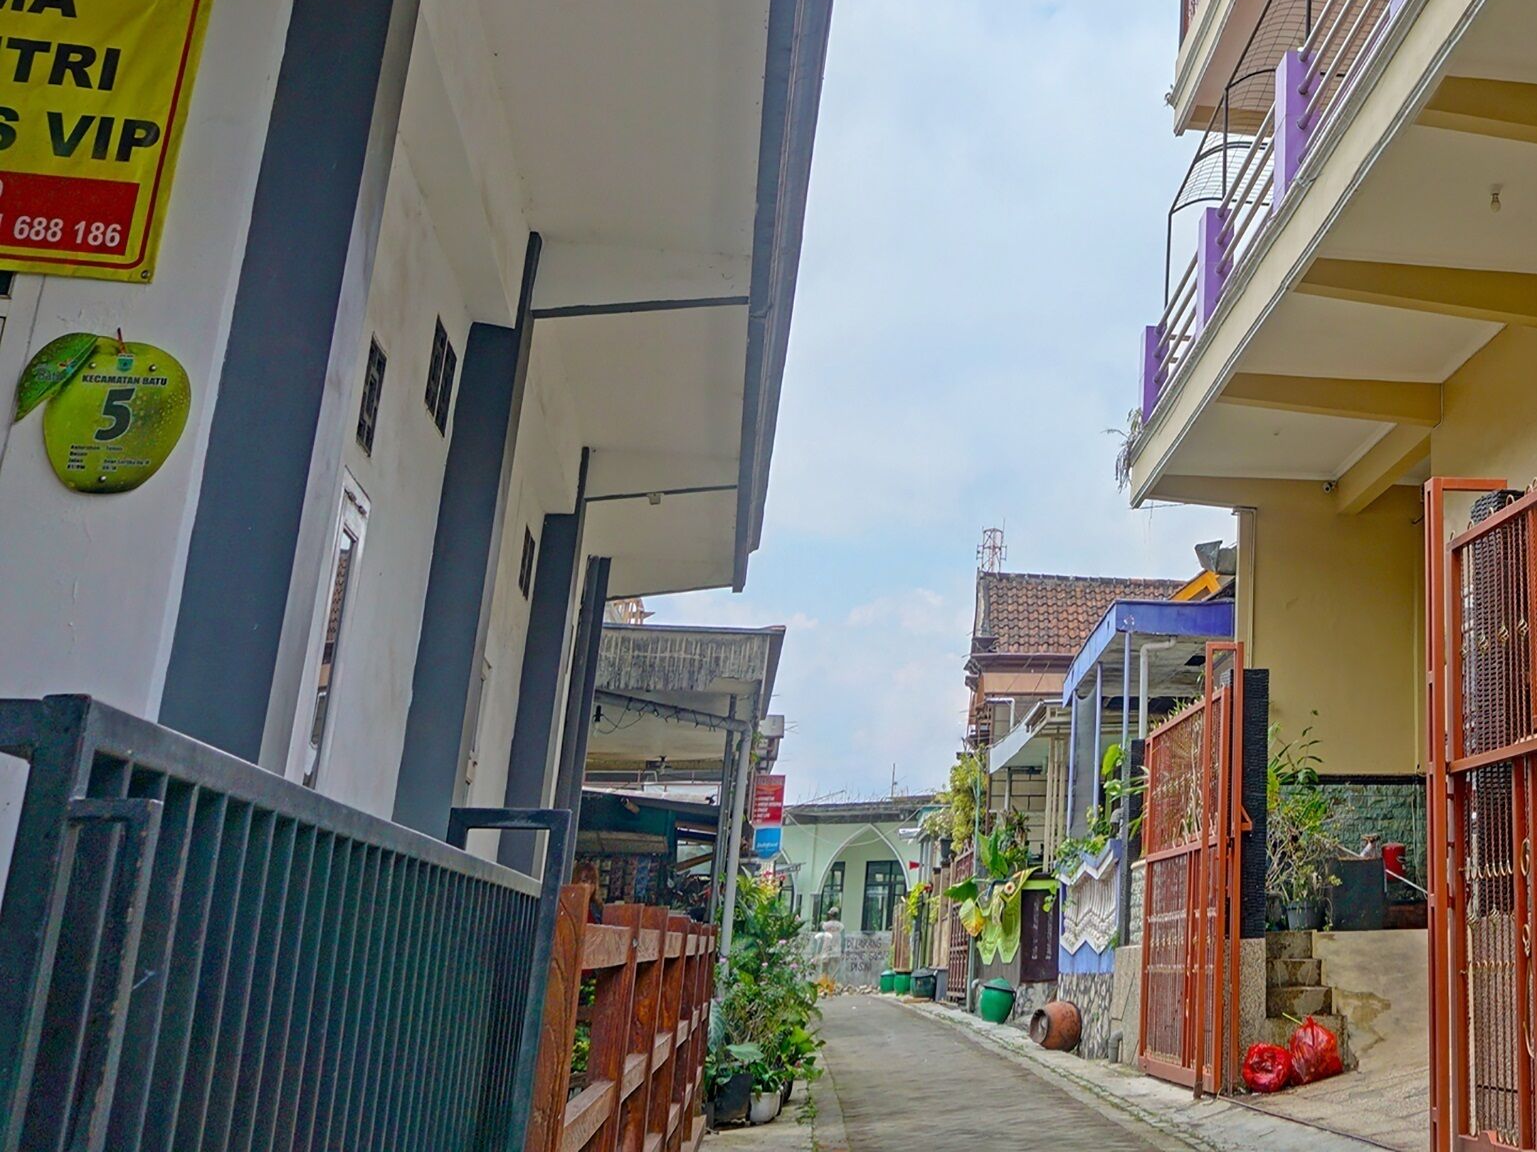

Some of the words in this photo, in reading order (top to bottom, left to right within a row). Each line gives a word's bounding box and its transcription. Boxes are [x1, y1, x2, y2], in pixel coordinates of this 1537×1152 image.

[0, 36, 121, 91] TRI
[47, 111, 161, 162] VIP
[13, 215, 64, 243] 688
[73, 220, 122, 247] 186
[82, 374, 139, 385] KECAMATAN
[142, 376, 168, 386] BATU
[94, 388, 135, 441] 5
